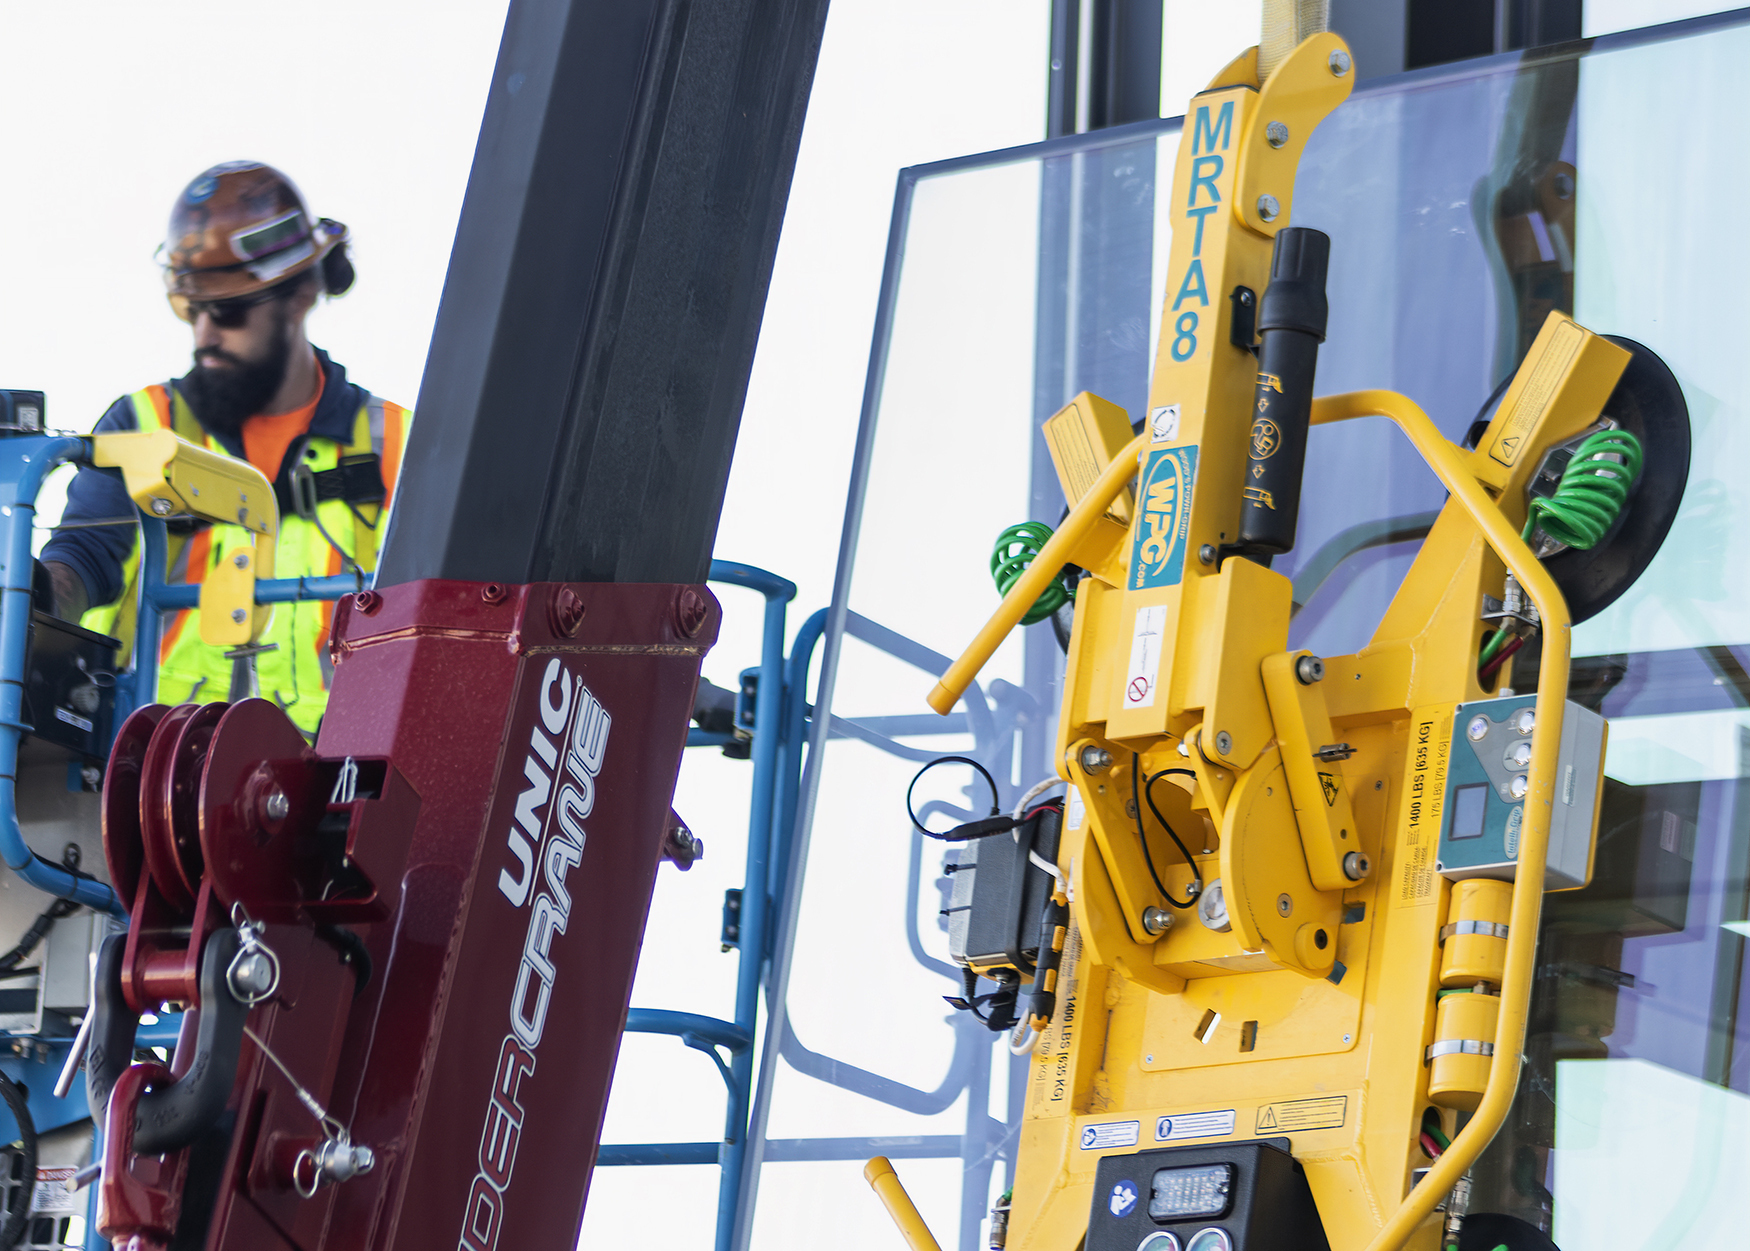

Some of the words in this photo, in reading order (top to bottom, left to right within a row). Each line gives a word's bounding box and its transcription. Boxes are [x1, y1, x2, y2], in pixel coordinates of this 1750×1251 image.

[1171, 101, 1235, 362] MRTA8
[1418, 721, 1434, 744] KG]
[1415, 746, 1429, 771] [635
[1438, 741, 1450, 758] KG]
[498, 657, 572, 907] UNIC
[1411, 774, 1425, 799] LBS
[1433, 782, 1443, 801] LBS
[1409, 801, 1422, 829] 1400
[1431, 802, 1441, 818] 175
[1063, 996, 1077, 1022] 1400
[1060, 1025, 1073, 1049] LBS
[1056, 1052, 1069, 1076] [635
[1050, 1079, 1066, 1102] KG]
